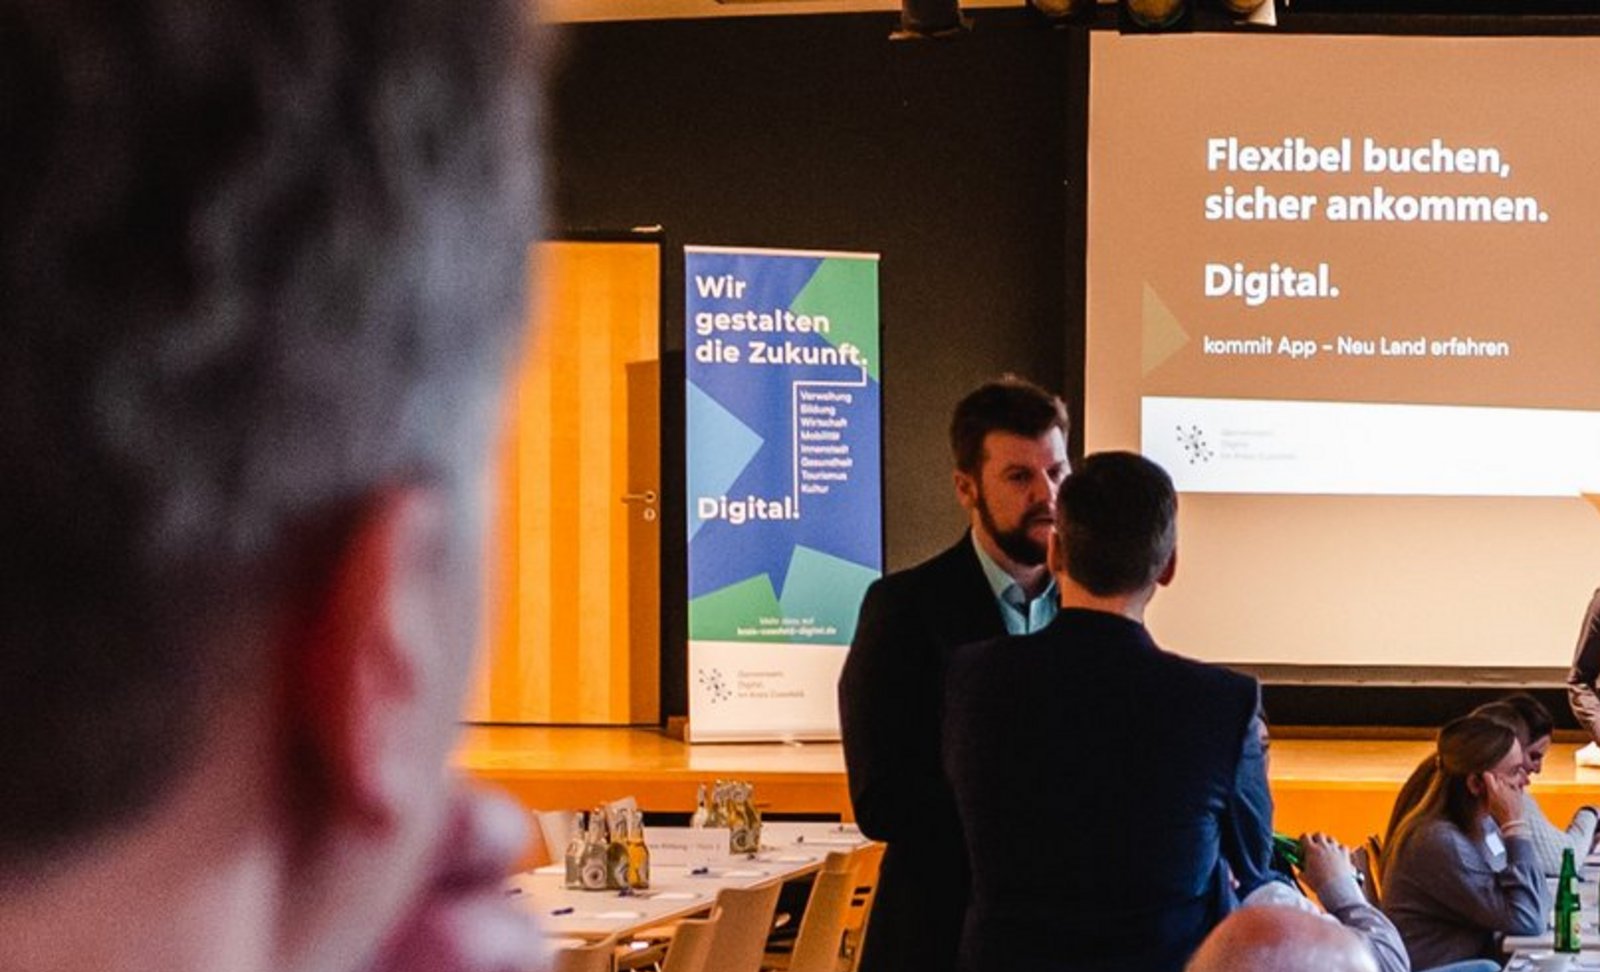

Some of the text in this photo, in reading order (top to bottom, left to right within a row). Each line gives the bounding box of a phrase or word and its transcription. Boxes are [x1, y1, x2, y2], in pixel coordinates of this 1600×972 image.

[1206, 137, 1510, 177] Flexibel buchen,
[1205, 186, 1549, 222] sicher ankommen.
[695, 274, 747, 299] Wir
[1204, 262, 1340, 305] Digital.
[695, 308, 830, 335] gestalten
[695, 338, 868, 366] die Zukunft.
[1203, 336, 1273, 354] kommit
[1277, 337, 1317, 357] App
[1337, 337, 1375, 355] Neu
[1380, 337, 1426, 356] Land
[1430, 338, 1510, 356] erfahren
[800, 391, 853, 404] Verwaltung
[800, 404, 836, 417] Bildung
[800, 417, 848, 428] Wirtschaft
[800, 457, 853, 468] Gesundheit
[800, 470, 848, 481] Tourismus
[800, 483, 830, 494] Kultur
